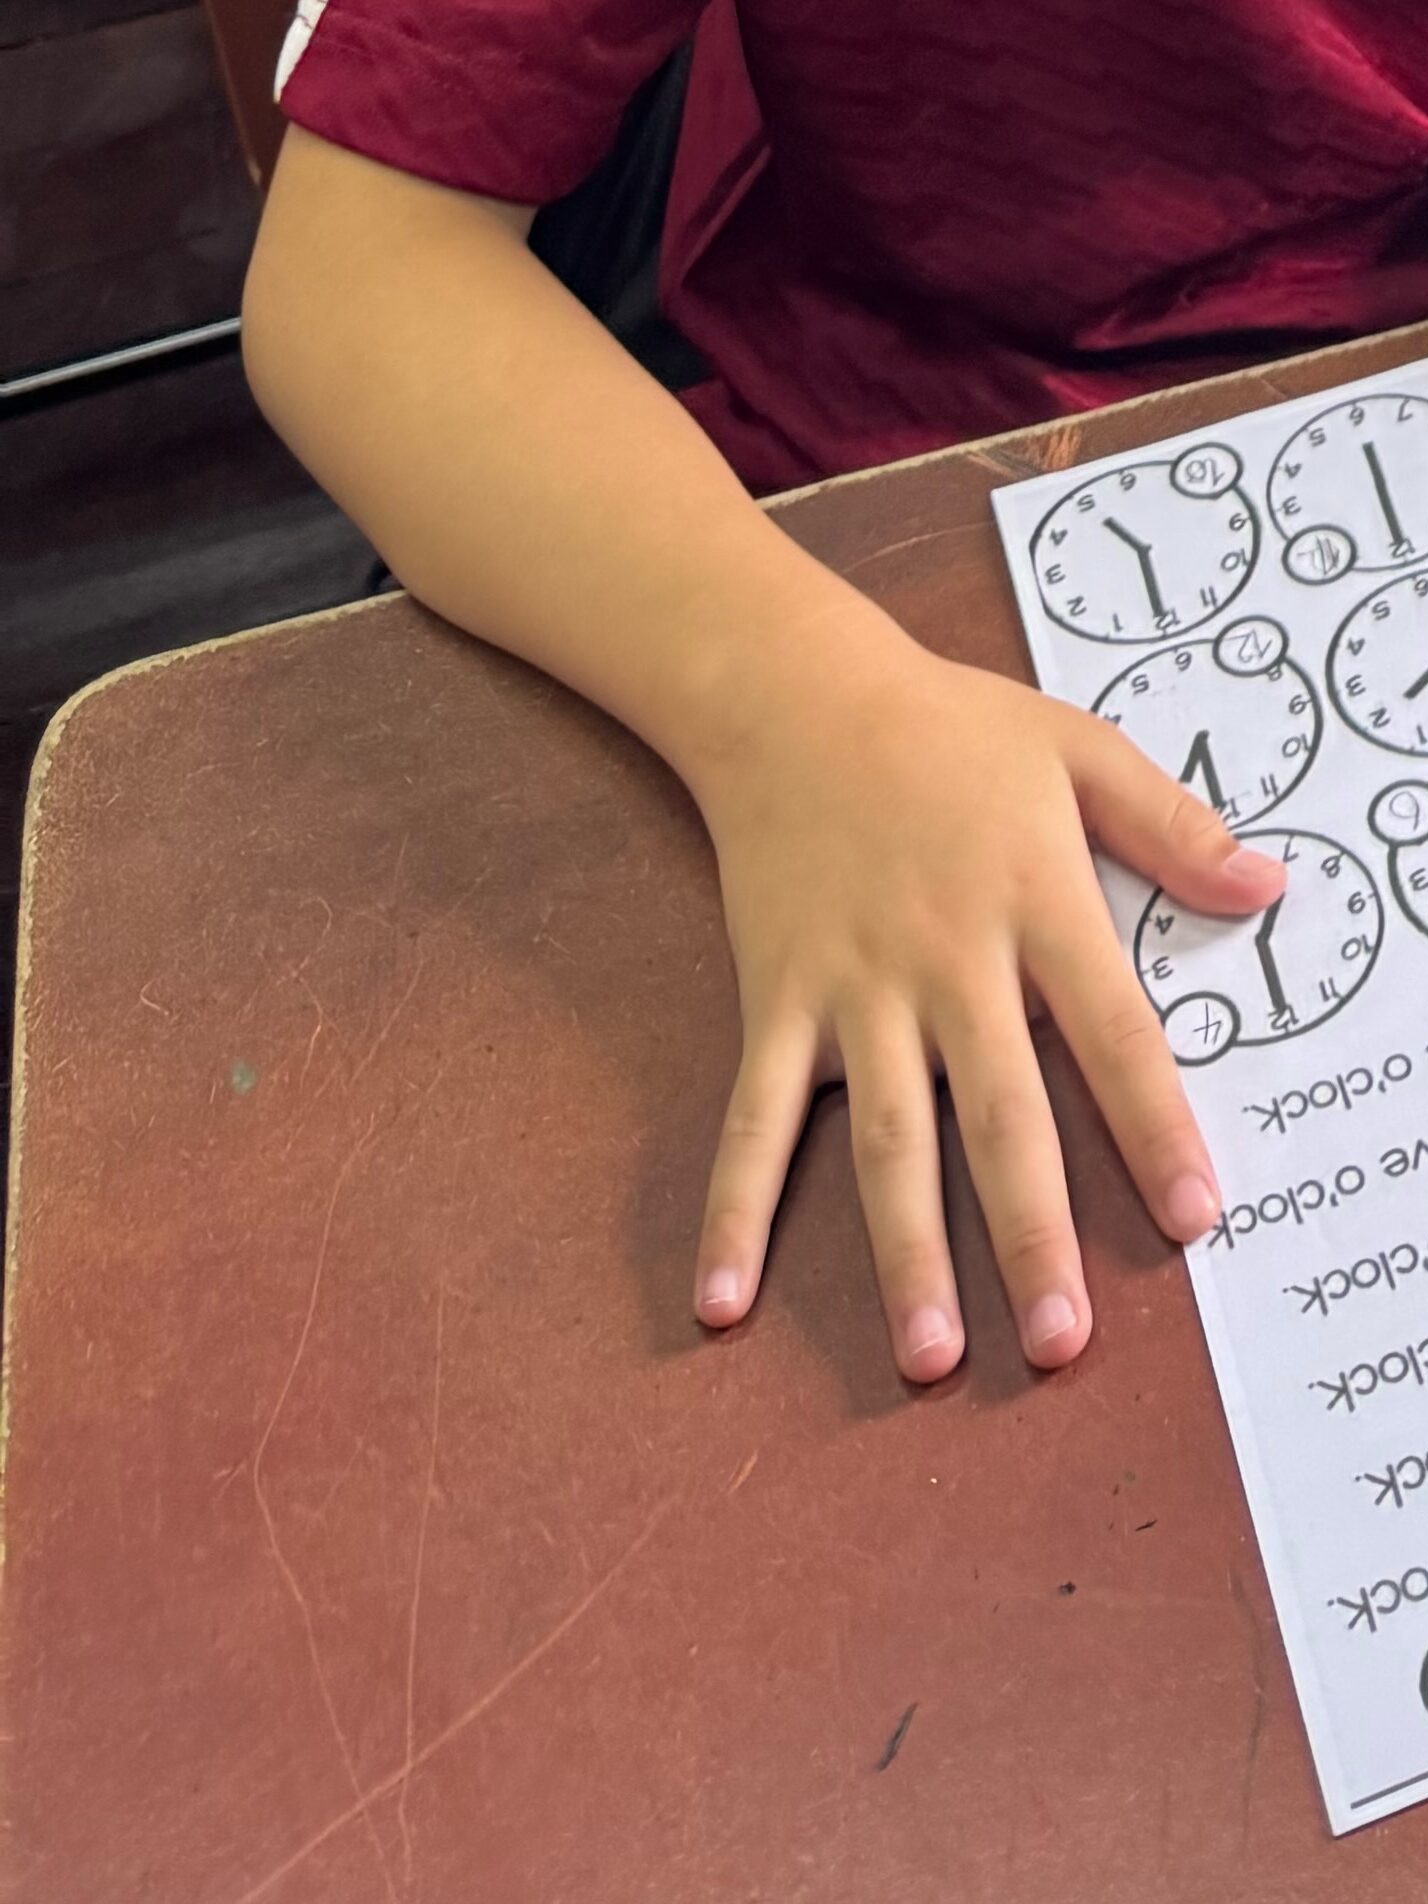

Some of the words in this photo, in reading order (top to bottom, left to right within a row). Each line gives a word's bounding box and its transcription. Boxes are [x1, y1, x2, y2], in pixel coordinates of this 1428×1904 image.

[1347, 405, 1365, 427] 6
[1396, 397, 1413, 423] 7
[1308, 426, 1326, 447] 5
[1283, 462, 1302, 479] 4
[1118, 472, 1137, 492] 6
[1075, 493, 1096, 513] 5
[1280, 495, 1302, 517] 3
[1227, 512, 1247, 532] 9
[1048, 528, 1068, 547] 4
[1387, 536, 1415, 559] 12
[1219, 547, 1251, 572] 10
[1043, 562, 1065, 585] 3
[1066, 595, 1087, 617] 2
[1199, 585, 1218, 607] 11
[1111, 612, 1123, 632] 1
[1151, 607, 1181, 631] 12
[1191, 995, 1230, 1045] 4
[1241, 1052, 1412, 1134] o'clock.
